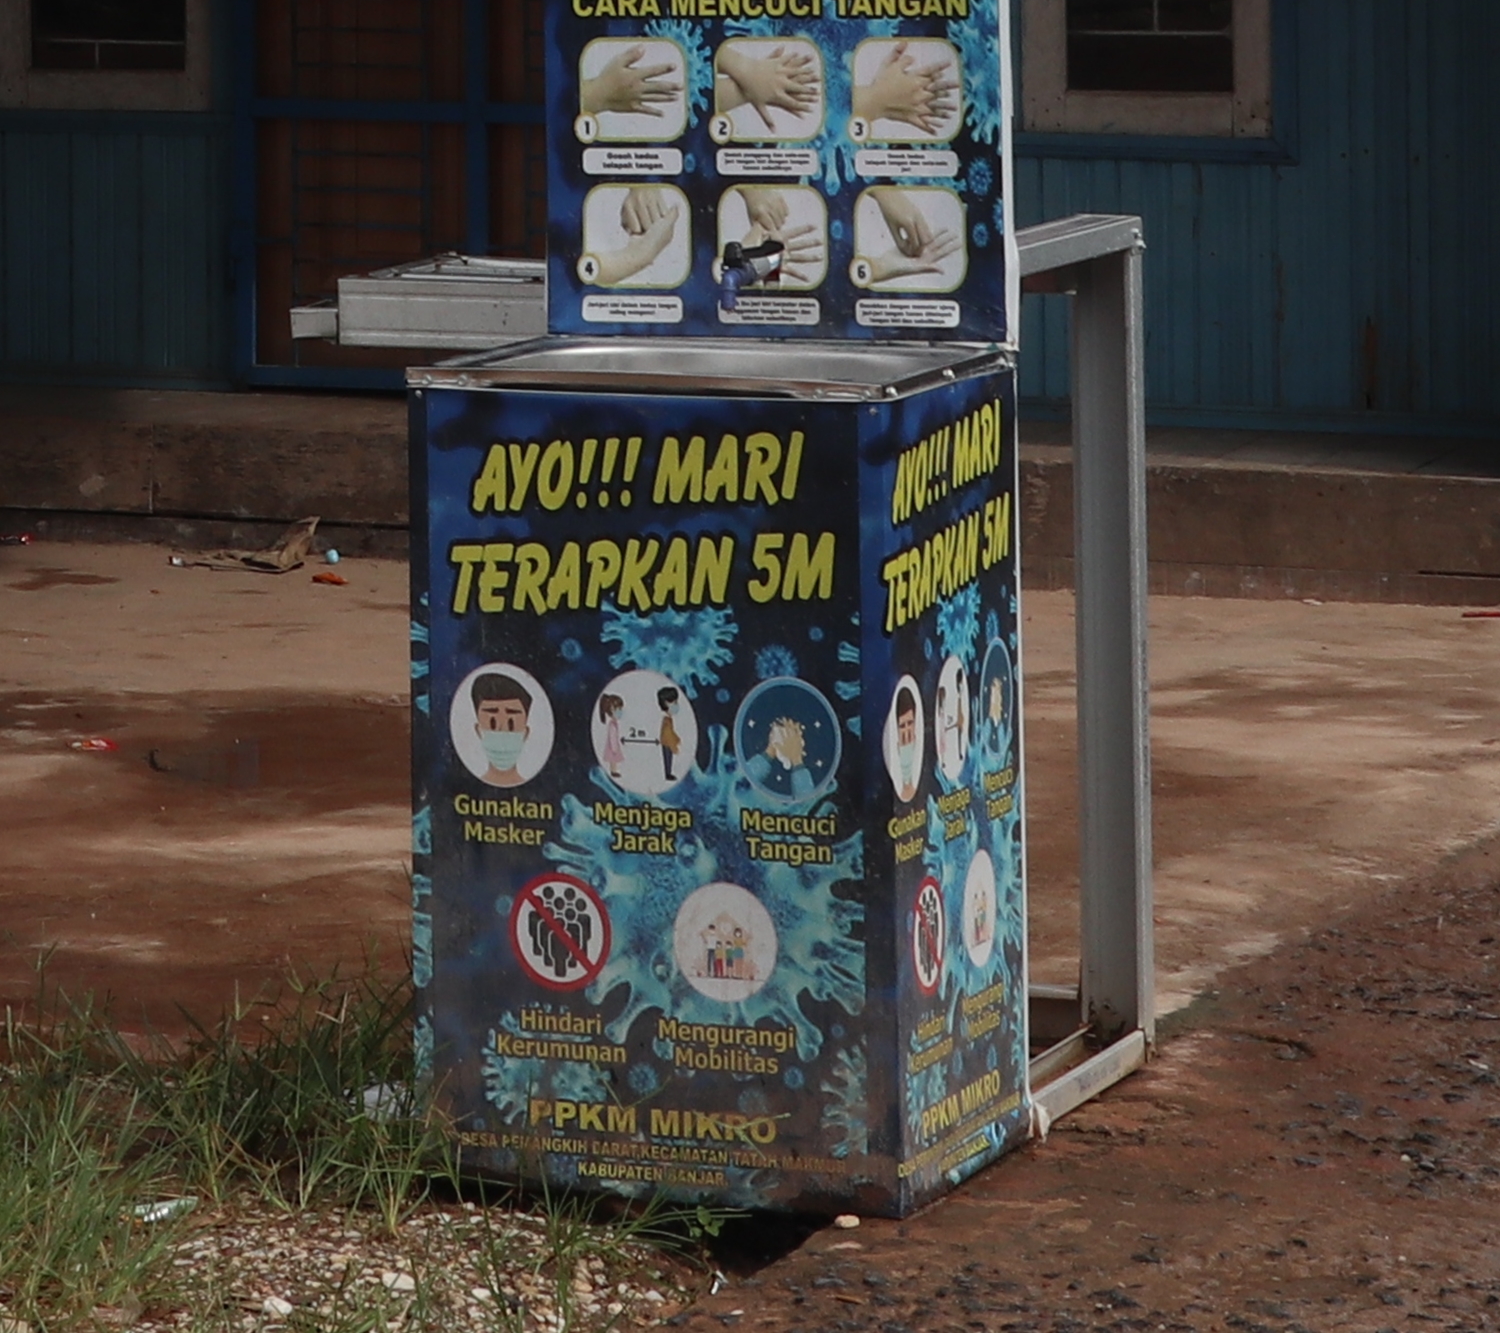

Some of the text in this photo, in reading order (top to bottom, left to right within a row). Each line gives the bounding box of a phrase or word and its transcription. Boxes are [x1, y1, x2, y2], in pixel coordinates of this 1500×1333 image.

[584, 121, 590, 136] 1
[718, 121, 727, 136] 2
[854, 122, 864, 137] 3
[584, 261, 594, 276] 4
[857, 264, 866, 280] 6
[472, 431, 805, 513] AYO!!! MARI
[892, 398, 1000, 524] AYO!!! MARI
[448, 533, 836, 616] TERAPKAN 5M
[883, 491, 1010, 633] TERAPKAN 5M
[984, 768, 1013, 793] Mencuci
[454, 794, 553, 820] Gunakan
[938, 788, 971, 814] Menjaga
[986, 794, 1013, 820] Tangan
[594, 802, 692, 830] Menjaga
[741, 810, 836, 836] Mencuci
[888, 808, 925, 839] Gunakan
[464, 821, 546, 846] Masker
[612, 829, 675, 855] Jarak
[746, 837, 833, 866] Tangan
[895, 836, 924, 864] Masker
[520, 1009, 602, 1035] Hindari
[658, 1018, 797, 1052] Mengurangi
[496, 1034, 628, 1064] Kerumunan
[674, 1047, 779, 1075] Mobilitas
[922, 1093, 961, 1139] PPKM
[961, 1069, 1000, 1115] MIKRO
[530, 1099, 777, 1145] PPKM MIKRO
[578, 1161, 663, 1181] KABUPATEN
